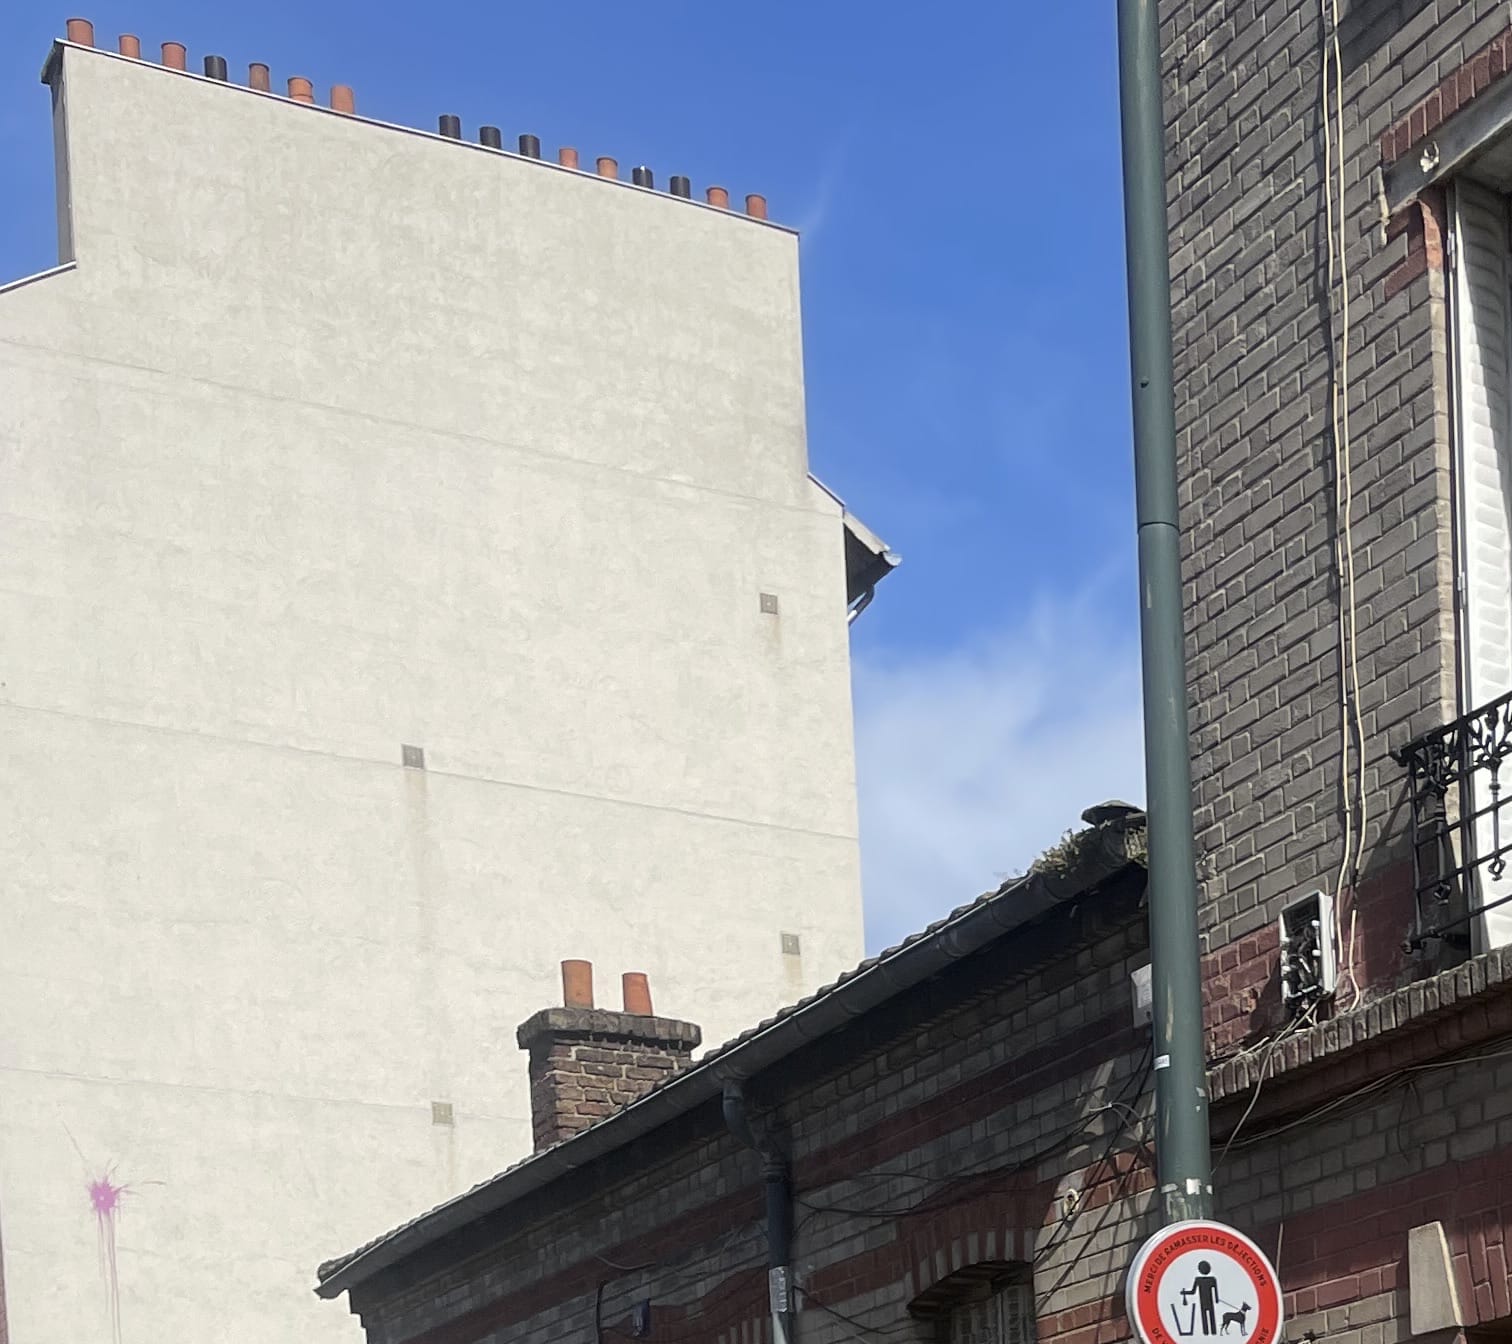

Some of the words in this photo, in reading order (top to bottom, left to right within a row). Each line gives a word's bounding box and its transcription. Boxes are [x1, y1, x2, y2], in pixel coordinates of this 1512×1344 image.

[1143, 1262, 1159, 1294] MERCI
[1154, 1253, 1167, 1266] DE
[1164, 1234, 1209, 1256] RAMASSER
[1210, 1235, 1226, 1247] LES
[1151, 1327, 1163, 1341] DE
